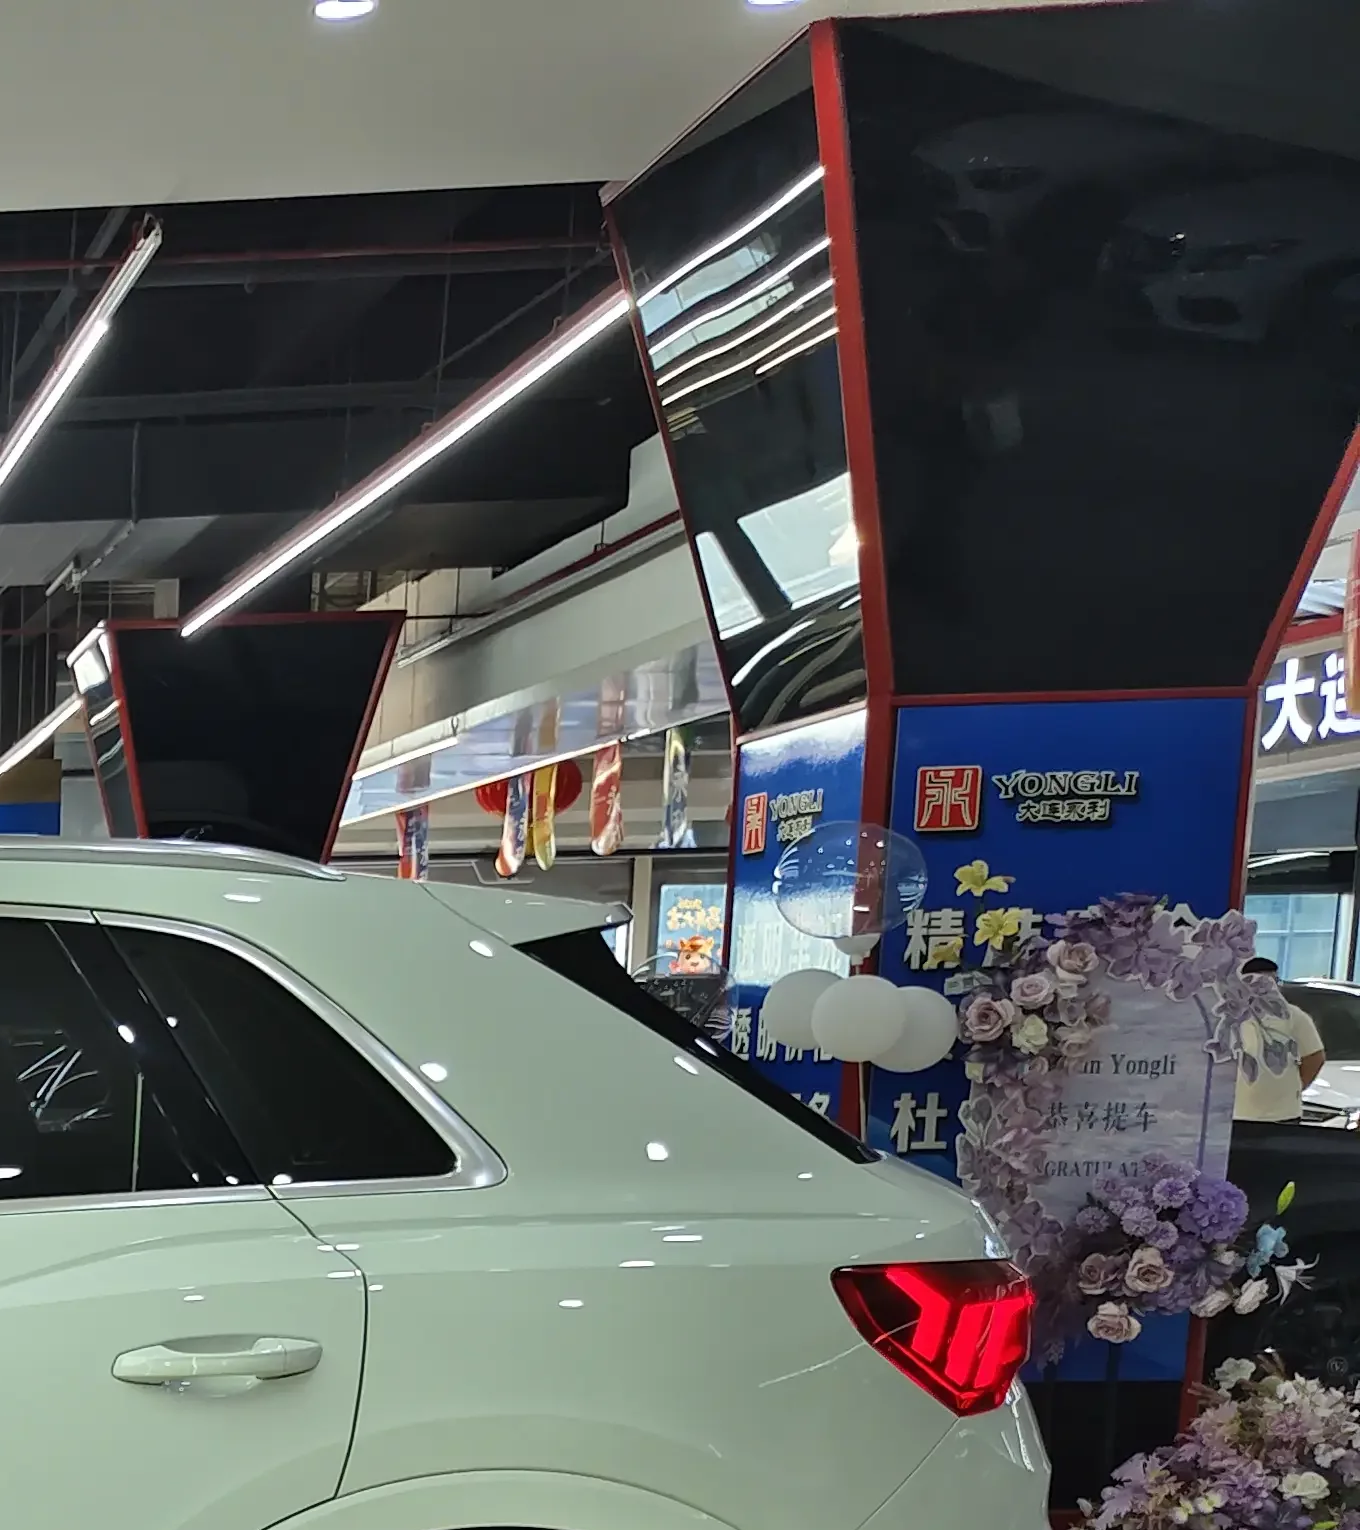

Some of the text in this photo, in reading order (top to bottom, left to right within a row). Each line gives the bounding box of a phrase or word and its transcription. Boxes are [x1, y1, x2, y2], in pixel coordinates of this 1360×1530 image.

[991, 769, 1140, 800] YONGLI
[769, 788, 824, 822] YONGLI
[1110, 1053, 1177, 1079] Yongli
